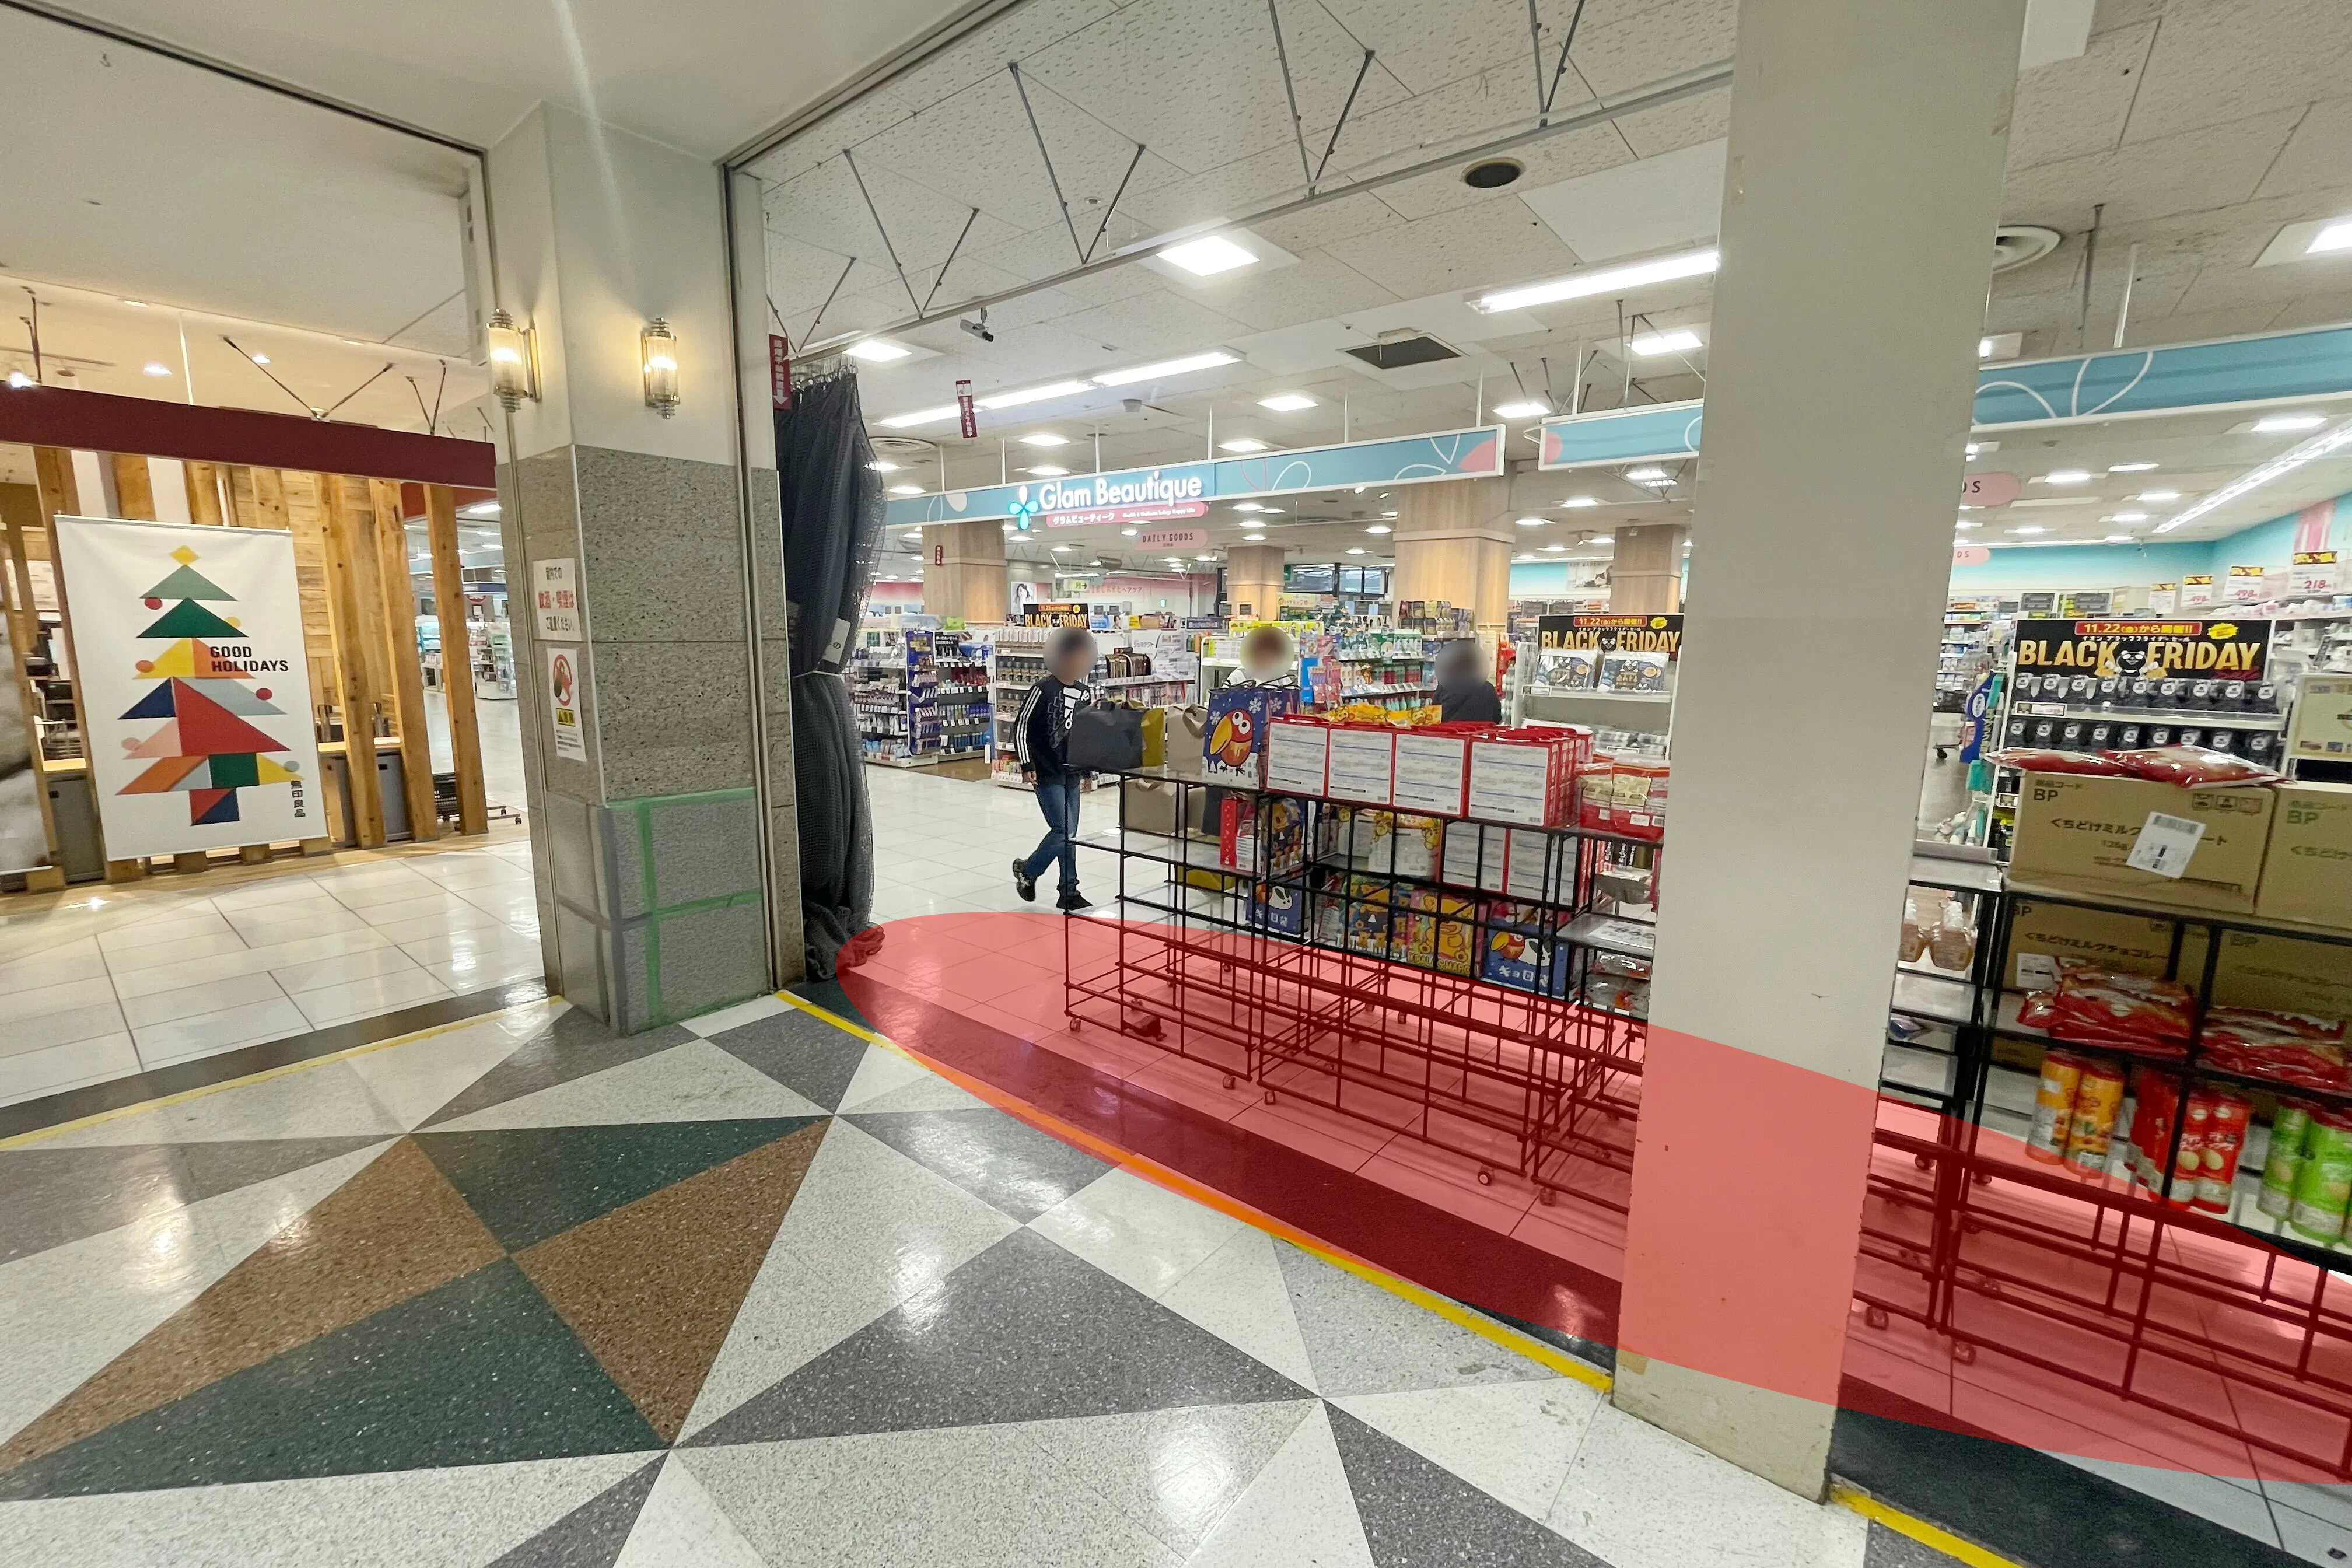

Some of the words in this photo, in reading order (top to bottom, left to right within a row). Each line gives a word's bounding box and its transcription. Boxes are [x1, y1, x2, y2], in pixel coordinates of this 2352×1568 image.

[1040, 481, 1091, 511] Glam
[1096, 470, 1202, 506] Beautique
[1053, 512, 1115, 524] グラムビューティーク
[1143, 533, 1166, 543] DAILY
[1169, 532, 1194, 542] GOODS
[1025, 614, 1052, 628] BLACK
[1059, 614, 1087, 628] FRIDAY
[1541, 631, 1601, 650] BLACK
[1616, 631, 1681, 652] FRIDAY
[210, 646, 252, 658] GOOD
[2018, 639, 2120, 668] BLACK
[2146, 641, 2261, 670] FRIDAY
[211, 660, 289, 672] HOLIDAYS
[2034, 788, 2059, 802] BP
[2287, 810, 2319, 824] BP
[2025, 932, 2170, 960] くちどけミルクチョコレー
